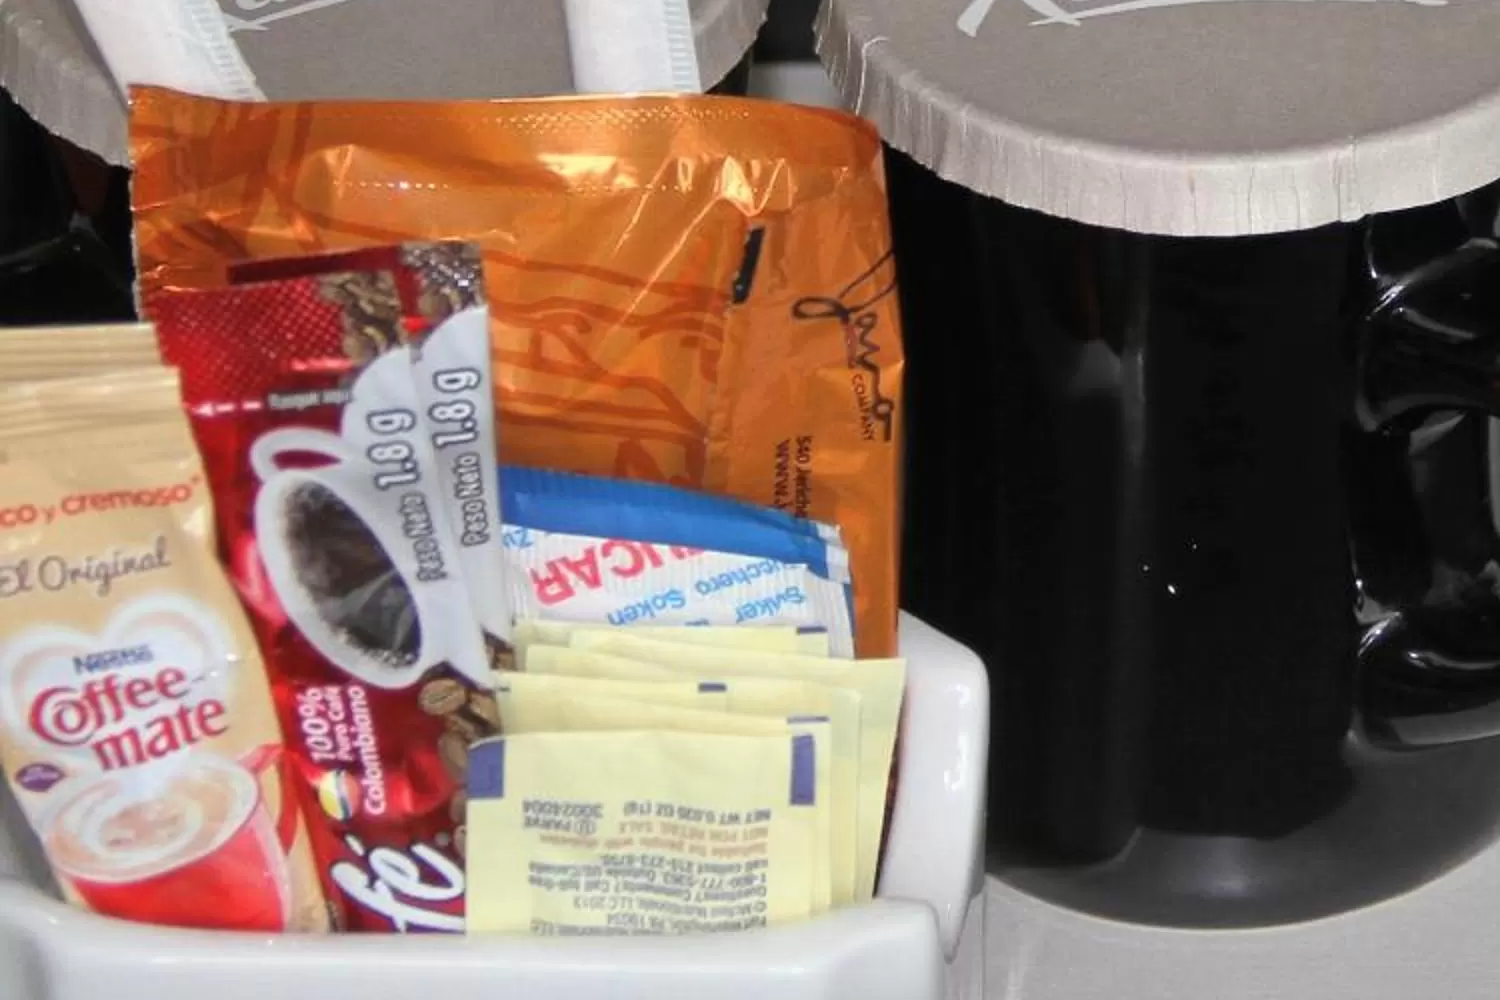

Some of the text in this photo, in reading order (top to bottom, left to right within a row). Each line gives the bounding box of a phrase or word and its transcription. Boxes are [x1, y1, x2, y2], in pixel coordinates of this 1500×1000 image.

[431, 367, 481, 393] g
[366, 408, 417, 435] g
[427, 399, 479, 450] 1.8
[365, 440, 421, 491] 1.8
[0, 503, 37, 527] co
[461, 498, 490, 547] Peso
[38, 535, 173, 597] Original
[92, 697, 229, 771] mate
[297, 687, 337, 762] 100%
[347, 685, 386, 815] Colombiano
